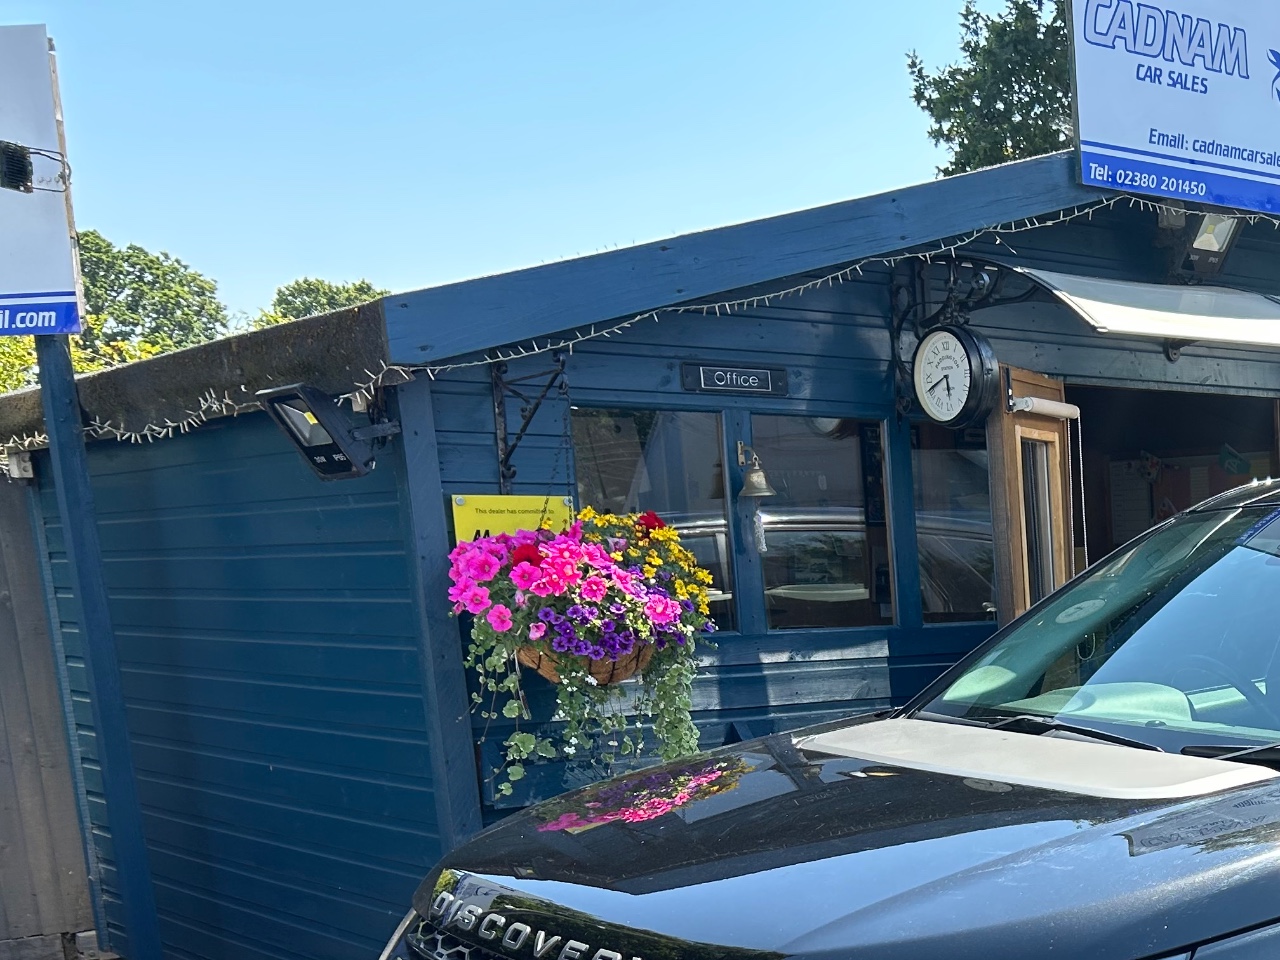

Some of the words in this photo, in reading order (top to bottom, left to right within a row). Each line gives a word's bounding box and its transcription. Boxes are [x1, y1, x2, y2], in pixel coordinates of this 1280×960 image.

[1084, 0, 1249, 79] CADNAM
[1136, 63, 1163, 87] CAR
[1167, 69, 1208, 94] SALES
[1148, 128, 1189, 151] Email:
[1089, 162, 1112, 182] Tel:
[1116, 169, 1158, 189] 02380
[1160, 176, 1206, 196] 201450
[714, 371, 759, 387] Office
